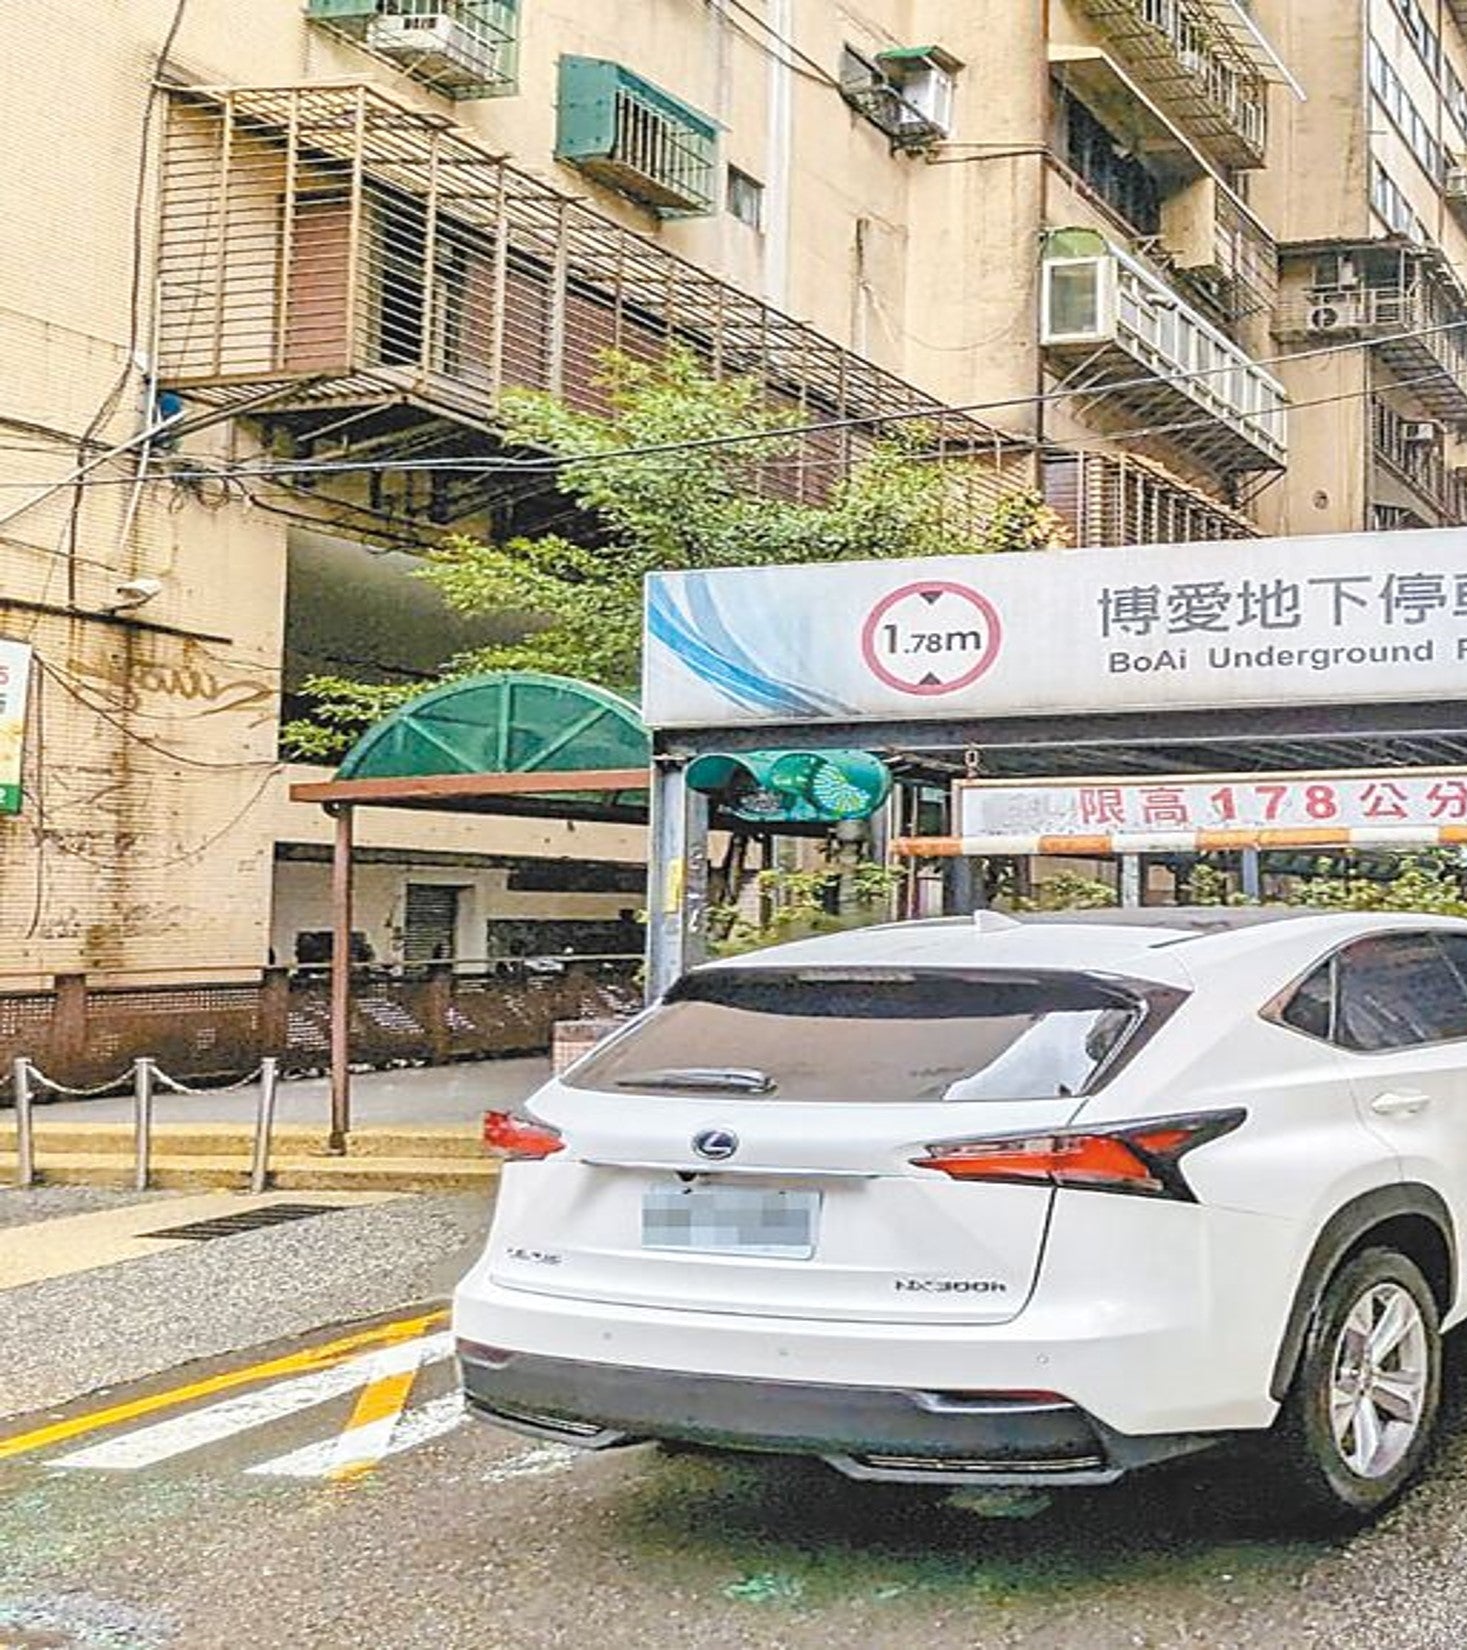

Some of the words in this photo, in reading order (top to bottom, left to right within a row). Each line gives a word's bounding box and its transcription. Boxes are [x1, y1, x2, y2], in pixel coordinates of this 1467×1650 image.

[883, 624, 982, 654] 1.78m
[1108, 648, 1187, 674] BoAi
[1208, 638, 1433, 671] Underground
